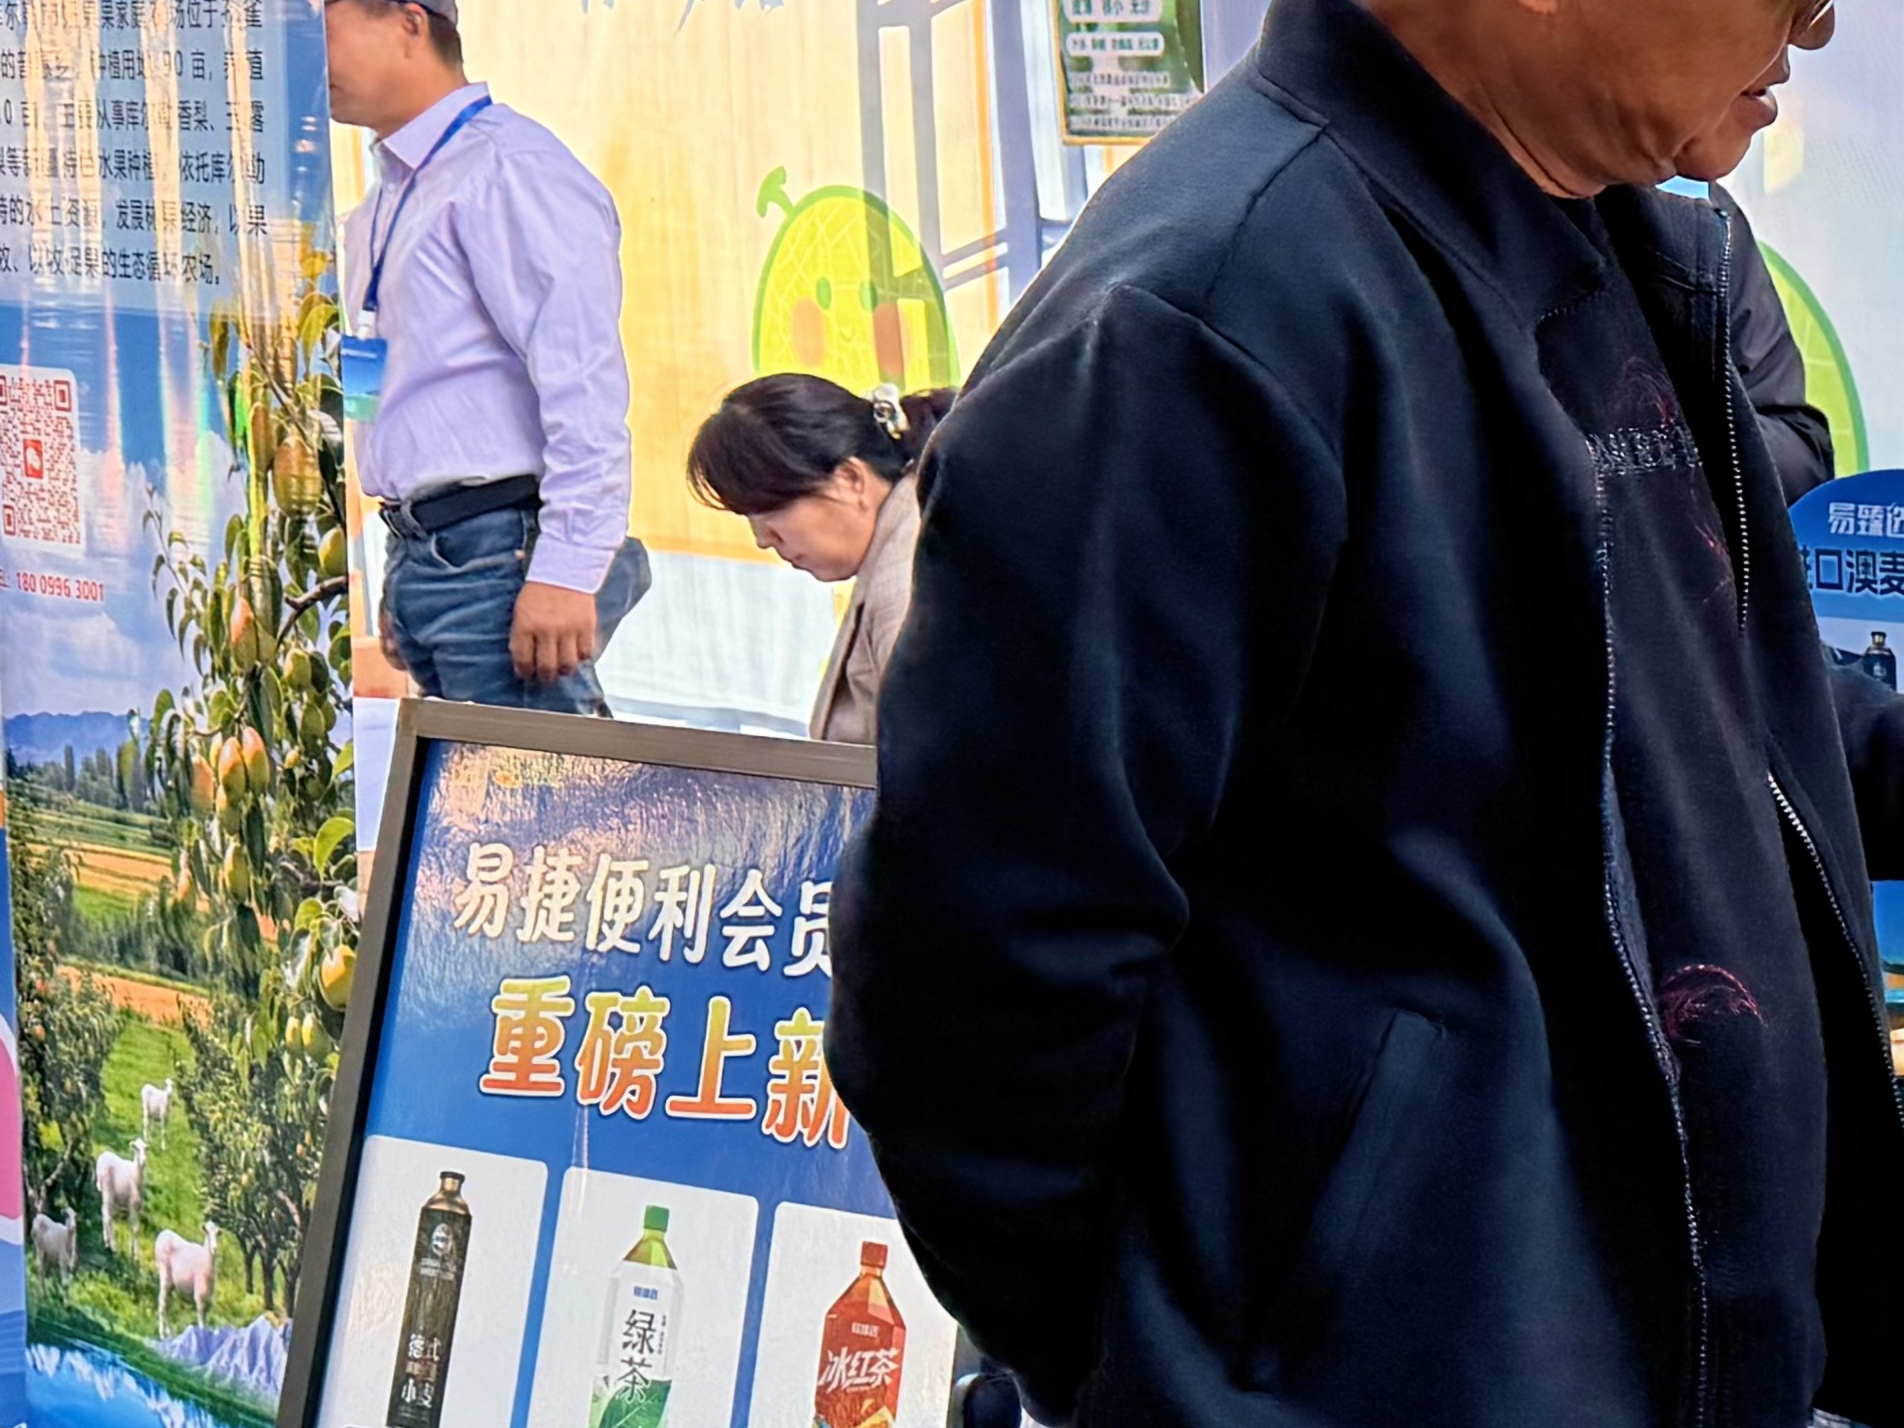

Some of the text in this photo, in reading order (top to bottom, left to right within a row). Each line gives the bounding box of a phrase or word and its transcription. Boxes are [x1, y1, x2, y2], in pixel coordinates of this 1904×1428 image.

[39, 575, 71, 596] 0996
[479, 974, 849, 1150] 重磅上新
[616, 1308, 656, 1404] 绿茶
[816, 1345, 901, 1394] 冰红茶
